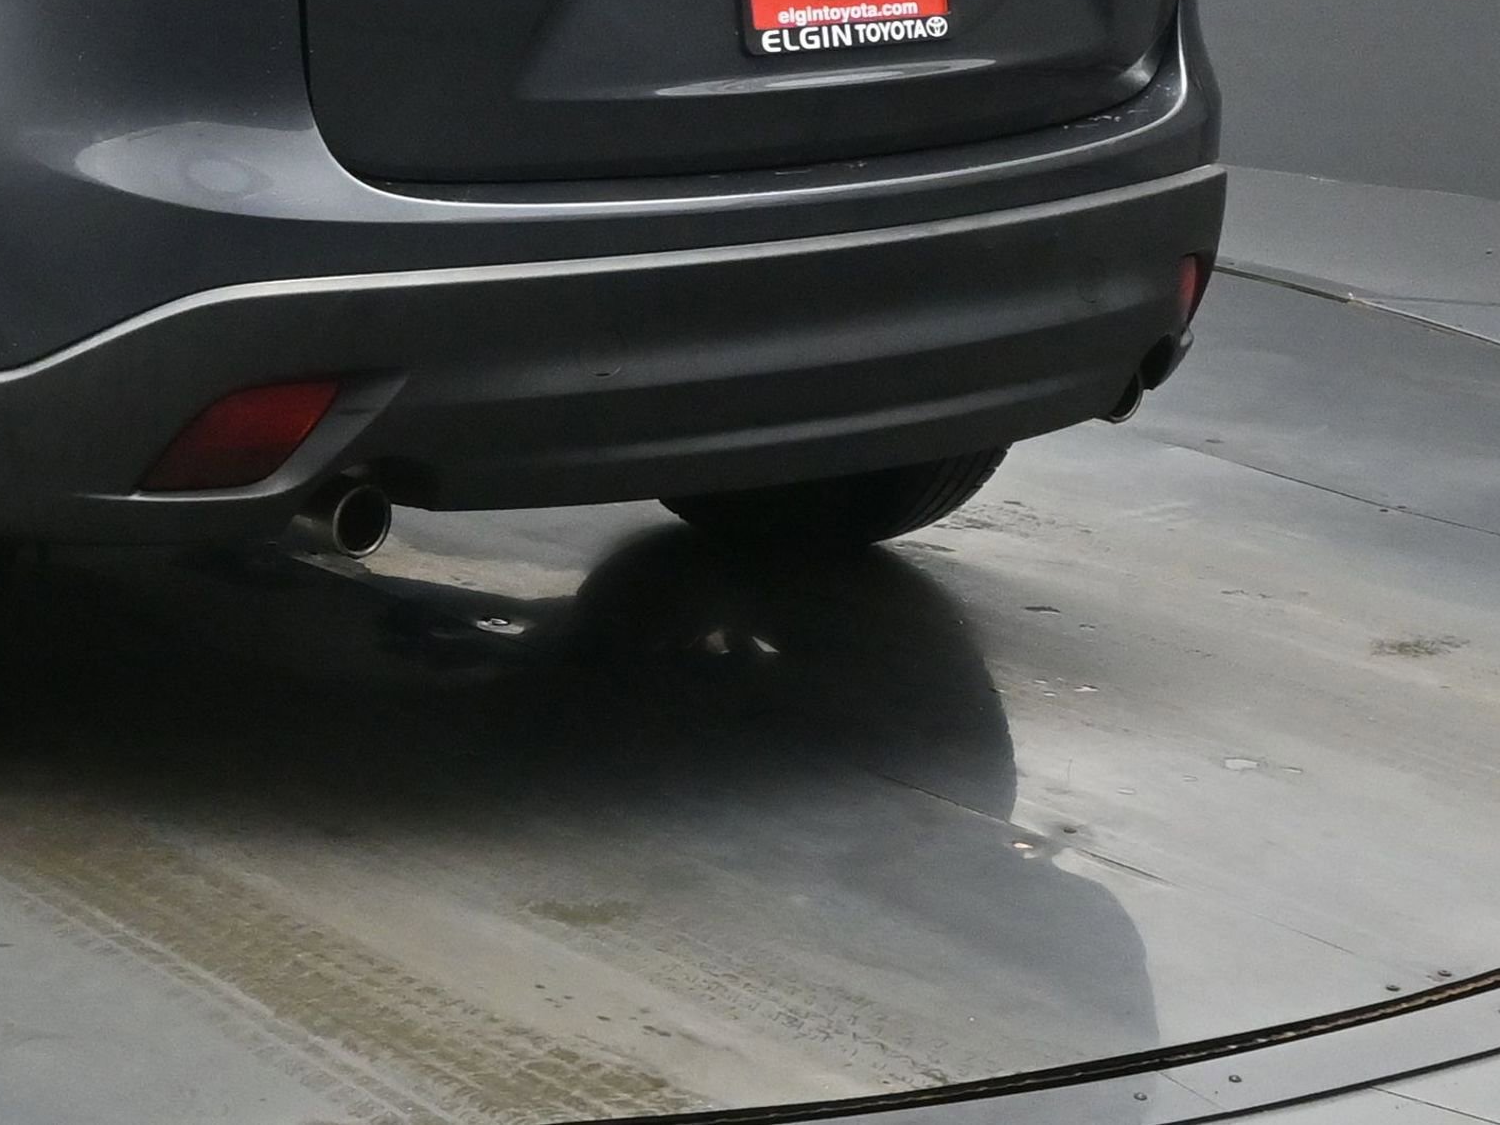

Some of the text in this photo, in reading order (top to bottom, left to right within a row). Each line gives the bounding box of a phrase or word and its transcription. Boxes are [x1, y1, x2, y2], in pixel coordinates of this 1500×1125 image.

[778, 2, 918, 25] elgintoyota.com
[762, 19, 927, 53] ELGIN TOYOTA
